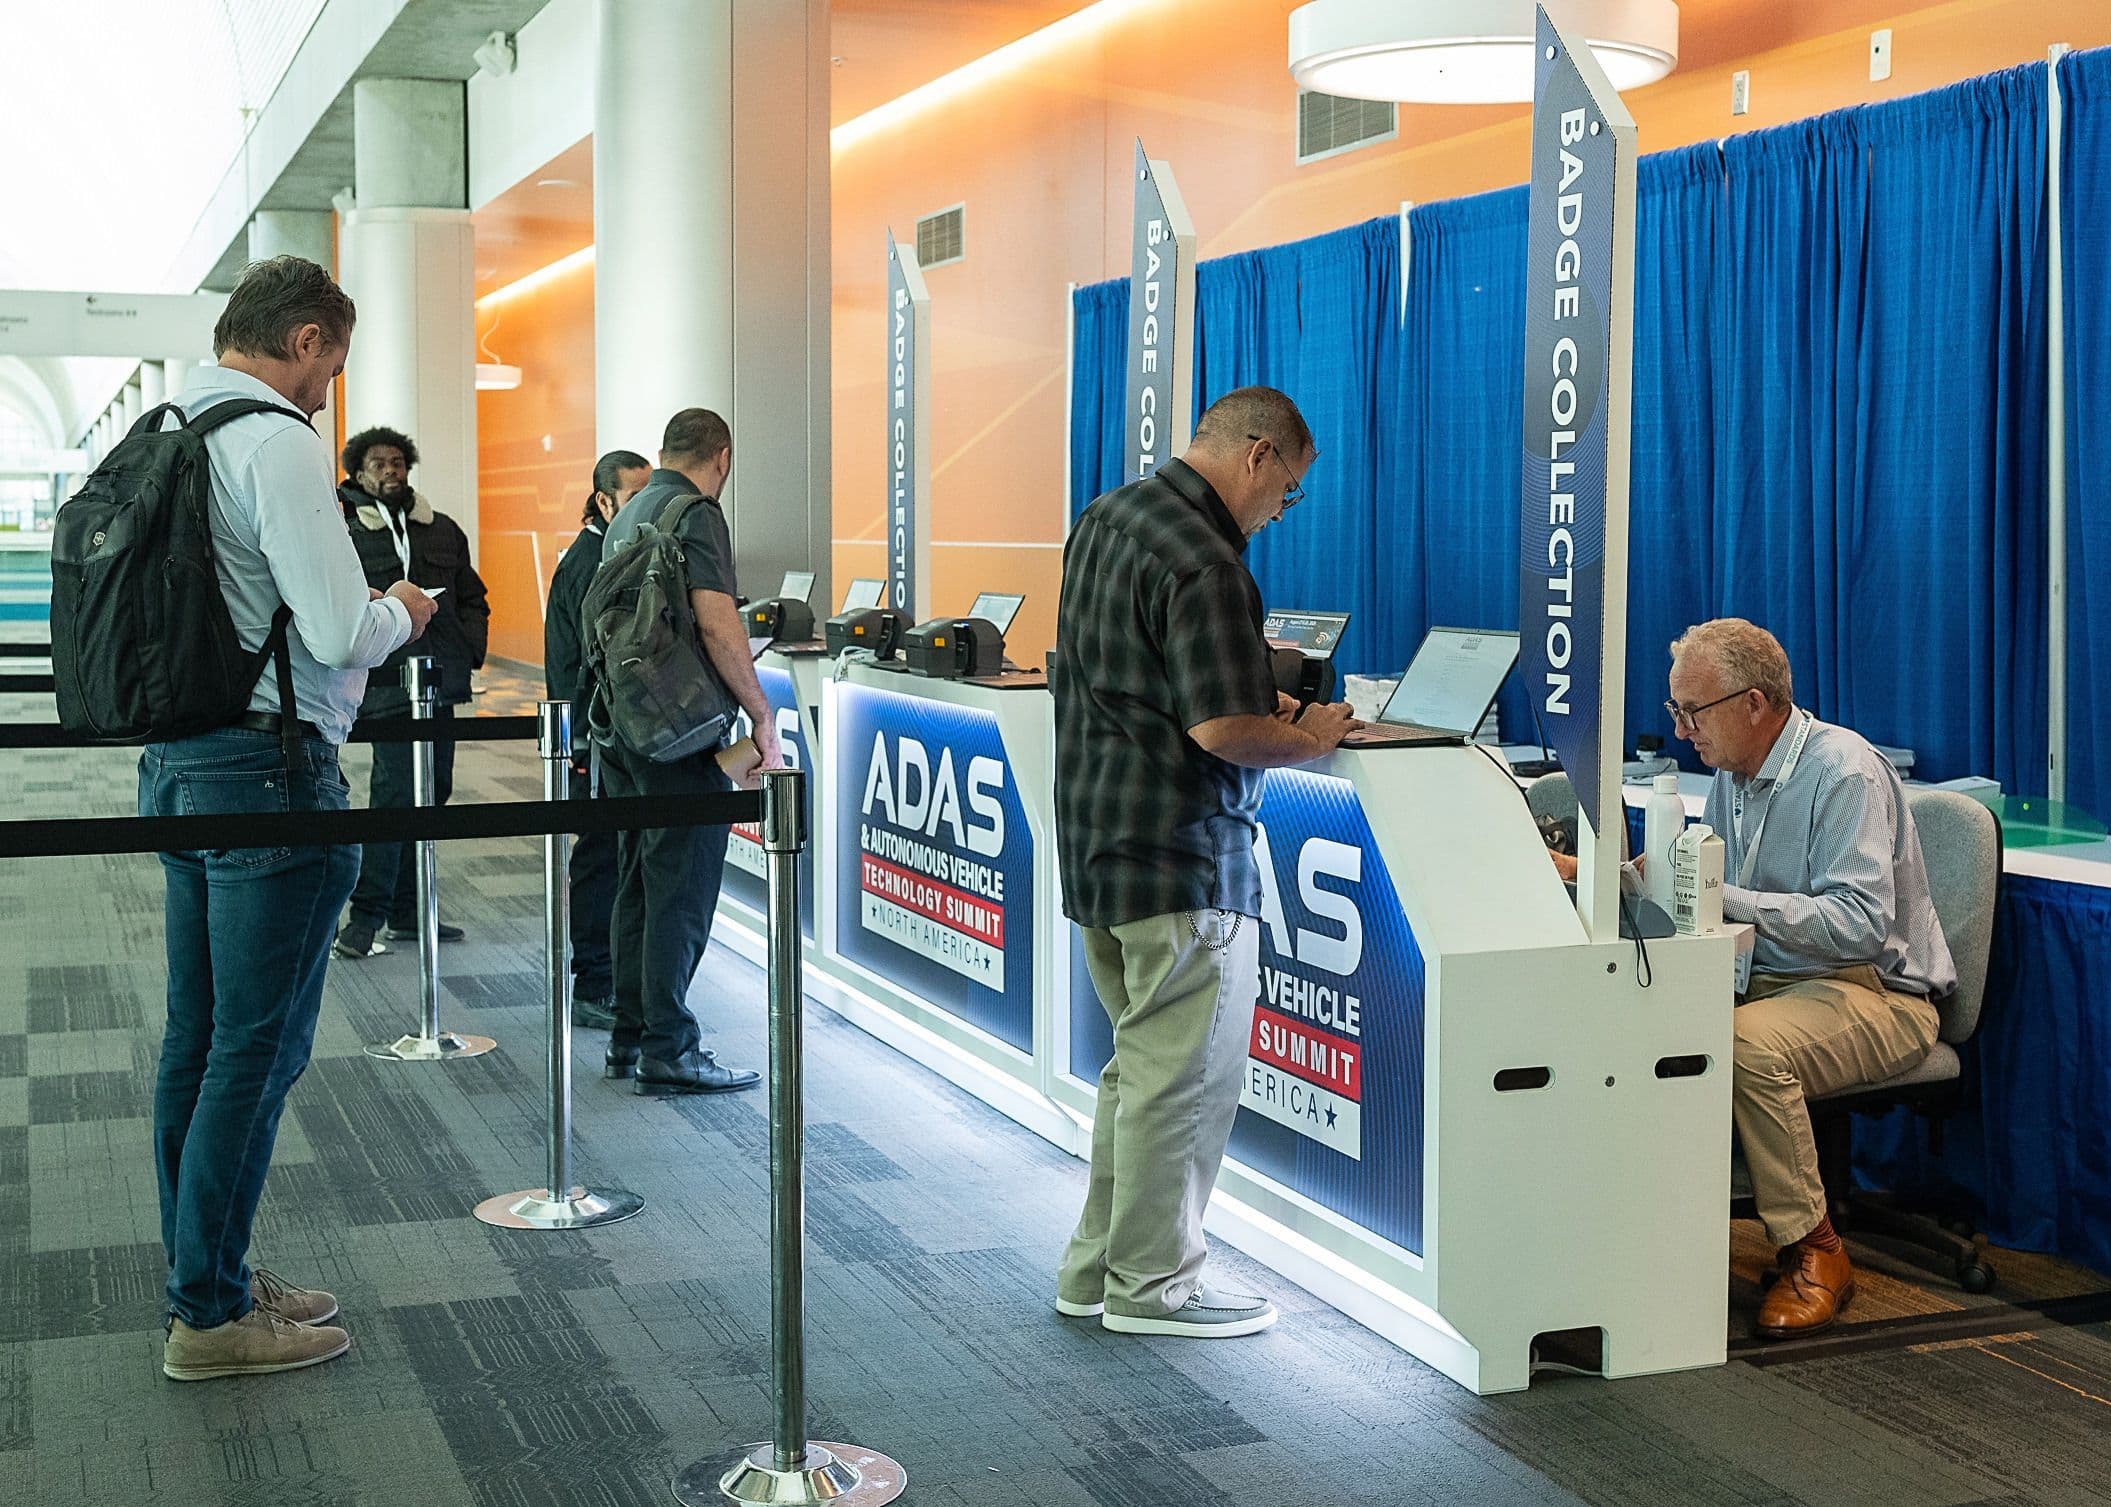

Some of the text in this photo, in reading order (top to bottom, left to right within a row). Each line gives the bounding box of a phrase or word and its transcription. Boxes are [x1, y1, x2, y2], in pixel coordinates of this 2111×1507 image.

[1142, 218, 1163, 374] BADGE
[894, 287, 906, 609] BADGE COLLECTIO
[1546, 107, 1586, 715] BADGE COLLECTION
[861, 729, 1004, 858] ADAS
[860, 823, 1004, 902] & AUTONOMOUS VEHICLE
[863, 861, 1001, 938] TECHNOLOGY SUMMIT
[1252, 821, 1363, 976] AS
[879, 904, 981, 967] NORTH AMERICA
[1264, 966, 1361, 1037] VEHICLE
[1258, 1019, 1354, 1086] SUMMIT
[1243, 1066, 1319, 1124] ERICA
